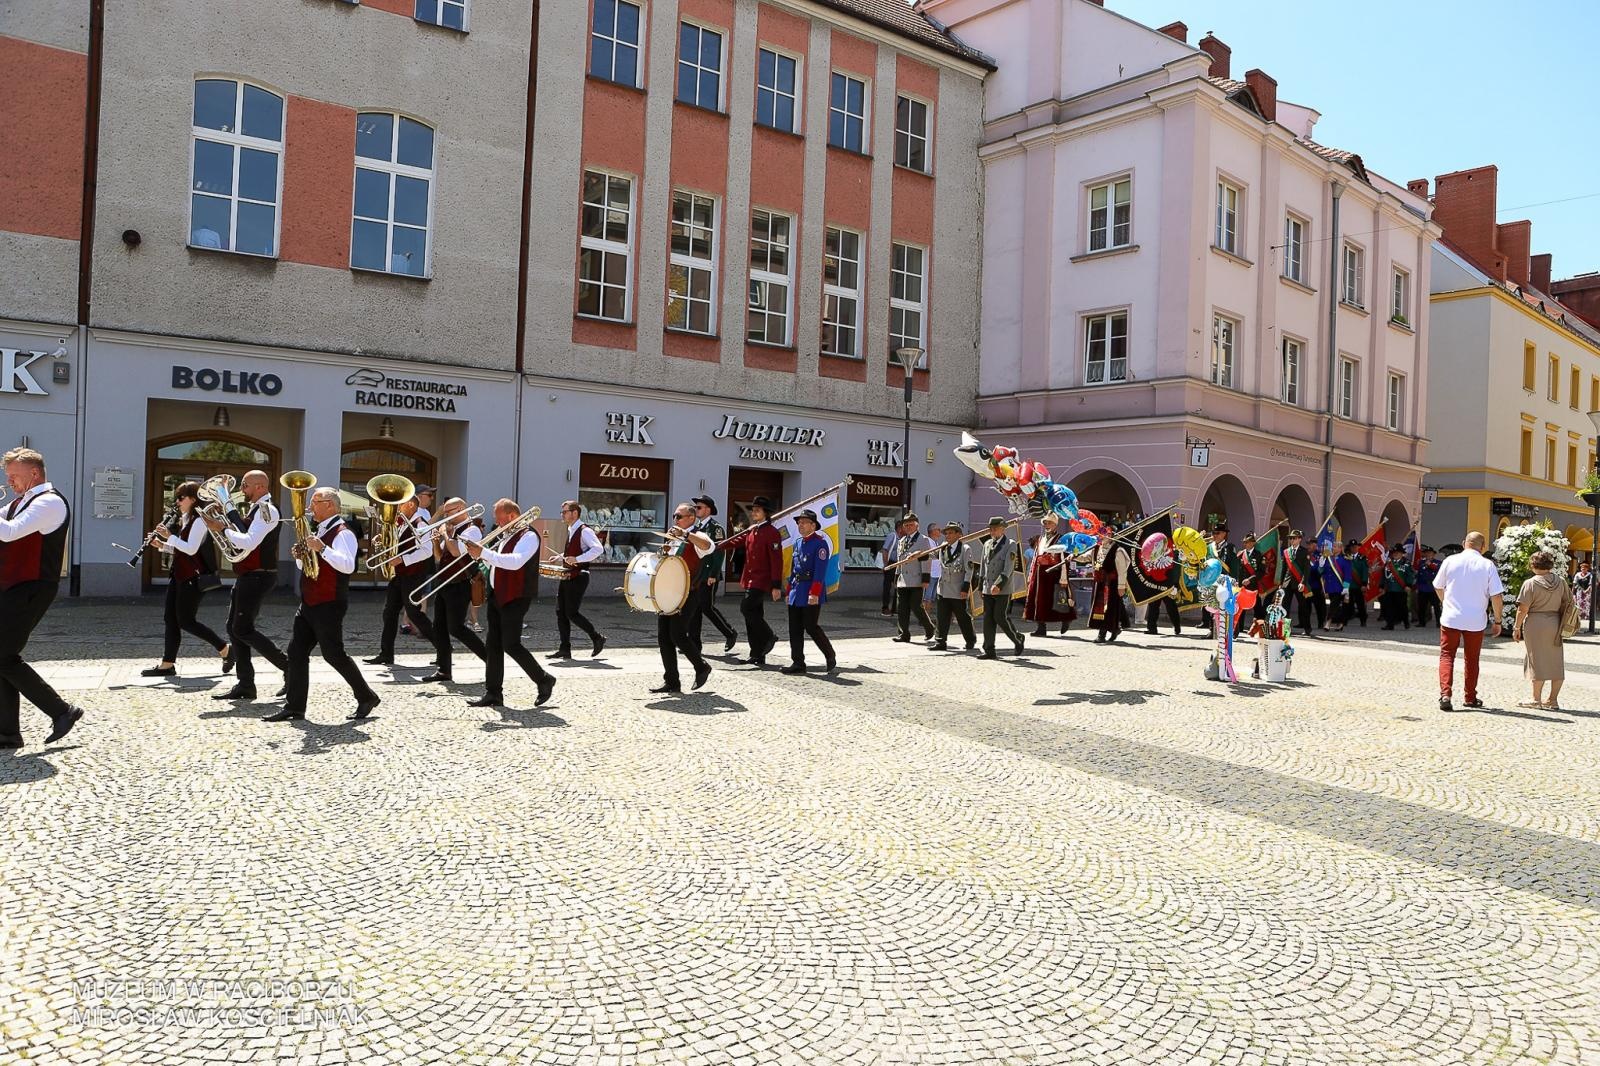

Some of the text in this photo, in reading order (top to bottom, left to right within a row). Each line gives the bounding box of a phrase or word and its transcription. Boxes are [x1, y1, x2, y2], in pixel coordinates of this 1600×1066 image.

[0, 347, 49, 395] K
[171, 365, 283, 396] BOLKO
[386, 378, 468, 397] RESTAURACJA
[355, 390, 457, 413] RACIBORSKA
[712, 414, 826, 447] JUBILER
[740, 446, 796, 463] ZŁOTNIK
[599, 463, 650, 480] ZŁOTO
[856, 481, 900, 497] SREBRO
